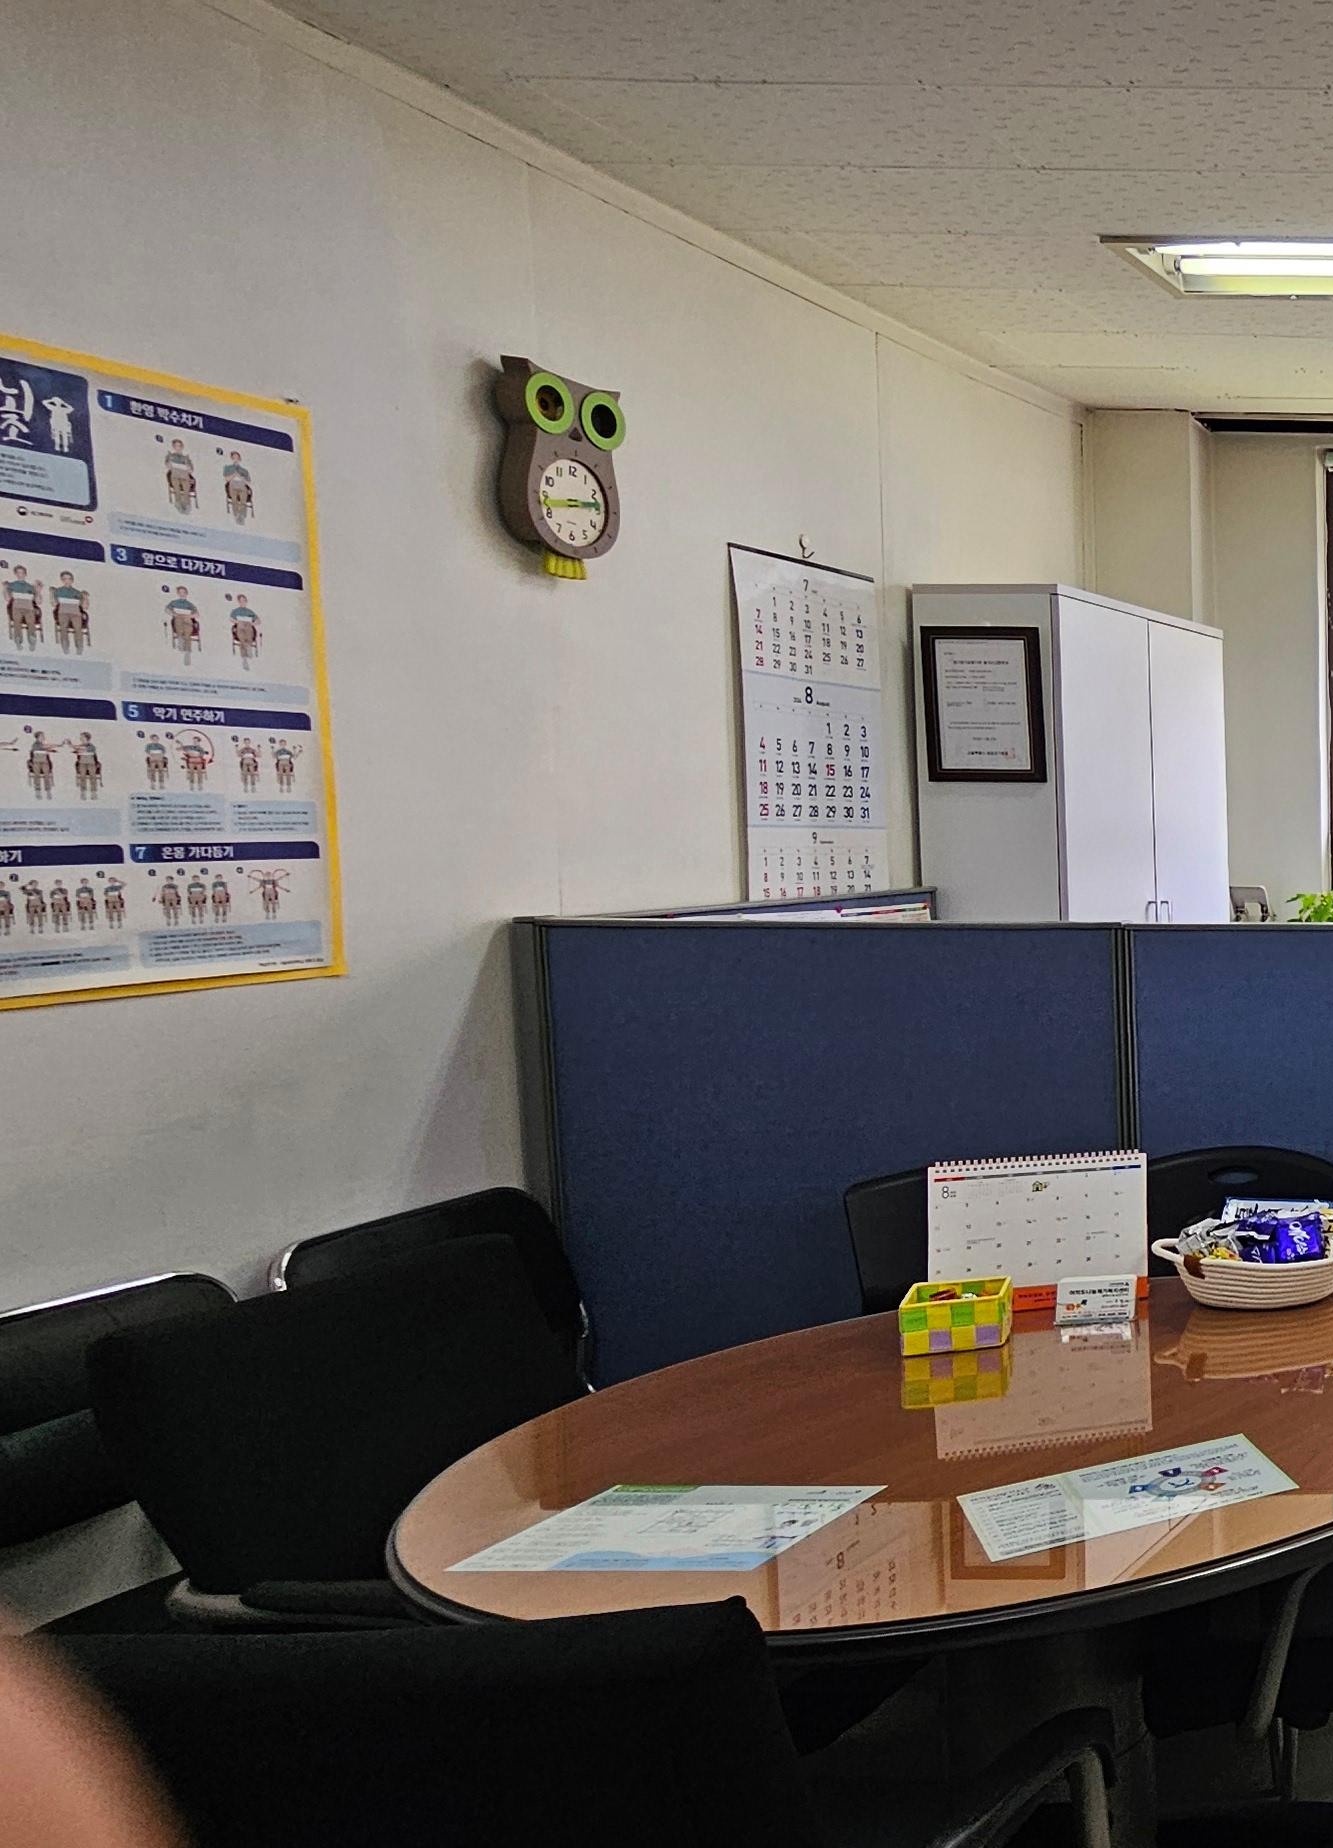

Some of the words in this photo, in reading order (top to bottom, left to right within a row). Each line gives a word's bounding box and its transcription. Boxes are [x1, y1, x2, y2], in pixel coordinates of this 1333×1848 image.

[104, 395, 112, 408] 1
[130, 400, 153, 418] 환영
[156, 408, 203, 429] 박수치기
[568, 466, 577, 477] 12
[545, 476, 554, 487] 10
[591, 490, 596, 499] 2
[547, 509, 553, 519] 8
[556, 523, 562, 533] 7
[590, 520, 596, 530] 4
[569, 531, 575, 541] 6
[582, 530, 587, 540] 5
[116, 548, 127, 561] 3
[142, 553, 178, 569] 앞으로
[181, 560, 226, 576] 다가가기
[803, 580, 808, 591] 7
[805, 687, 813, 704] 8
[127, 705, 139, 718] 5
[152, 707, 178, 721] 악기
[180, 708, 226, 723] 연주하기
[827, 723, 831, 734] 1
[844, 725, 849, 736] 2
[861, 727, 867, 737] 3
[760, 737, 765, 749] 4
[777, 739, 781, 750] 5
[793, 741, 797, 752] 6
[809, 742, 814, 753] 7
[827, 744, 832, 755] 8
[844, 745, 850, 757] 9
[861, 747, 869, 758] 10
[759, 760, 767, 771] 11
[776, 761, 783, 773] 12
[792, 762, 800, 774] 13
[808, 764, 817, 775] 14
[826, 765, 835, 776] 15
[844, 766, 852, 777] 16
[861, 767, 869, 778] 17
[759, 782, 768, 794] 18
[776, 783, 784, 794] 19
[792, 784, 801, 795] 20
[808, 785, 817, 796] 21
[825, 786, 835, 797] 22
[843, 786, 853, 797] 23
[861, 787, 870, 798] 24
[760, 804, 769, 816] 25
[776, 805, 785, 816] 26
[793, 805, 802, 817] 27
[809, 806, 819, 817] 28
[826, 806, 836, 818] 29
[844, 807, 854, 818] 30
[861, 808, 870, 818] 31
[812, 832, 817, 844] 9
[135, 847, 146, 859] 7
[161, 846, 186, 859] 온몸
[188, 846, 234, 859] 가다듬기
[764, 857, 767, 866] 1
[780, 857, 784, 866] 2
[797, 857, 801, 866] 3
[814, 857, 818, 866] 4
[830, 857, 835, 866] 5
[848, 856, 852, 865] 6
[865, 856, 869, 865] 7
[764, 873, 768, 882] 8
[780, 873, 784, 882] 9
[796, 872, 803, 881] 10
[813, 872, 819, 880] 11
[830, 871, 837, 880] 12
[847, 871, 854, 879] 13
[864, 870, 871, 879] 14
[763, 889, 770, 897] 15
[780, 888, 786, 896] 16
[797, 888, 804, 896] 17
[813, 887, 820, 896] 18
[942, 1186, 949, 1198] 8
